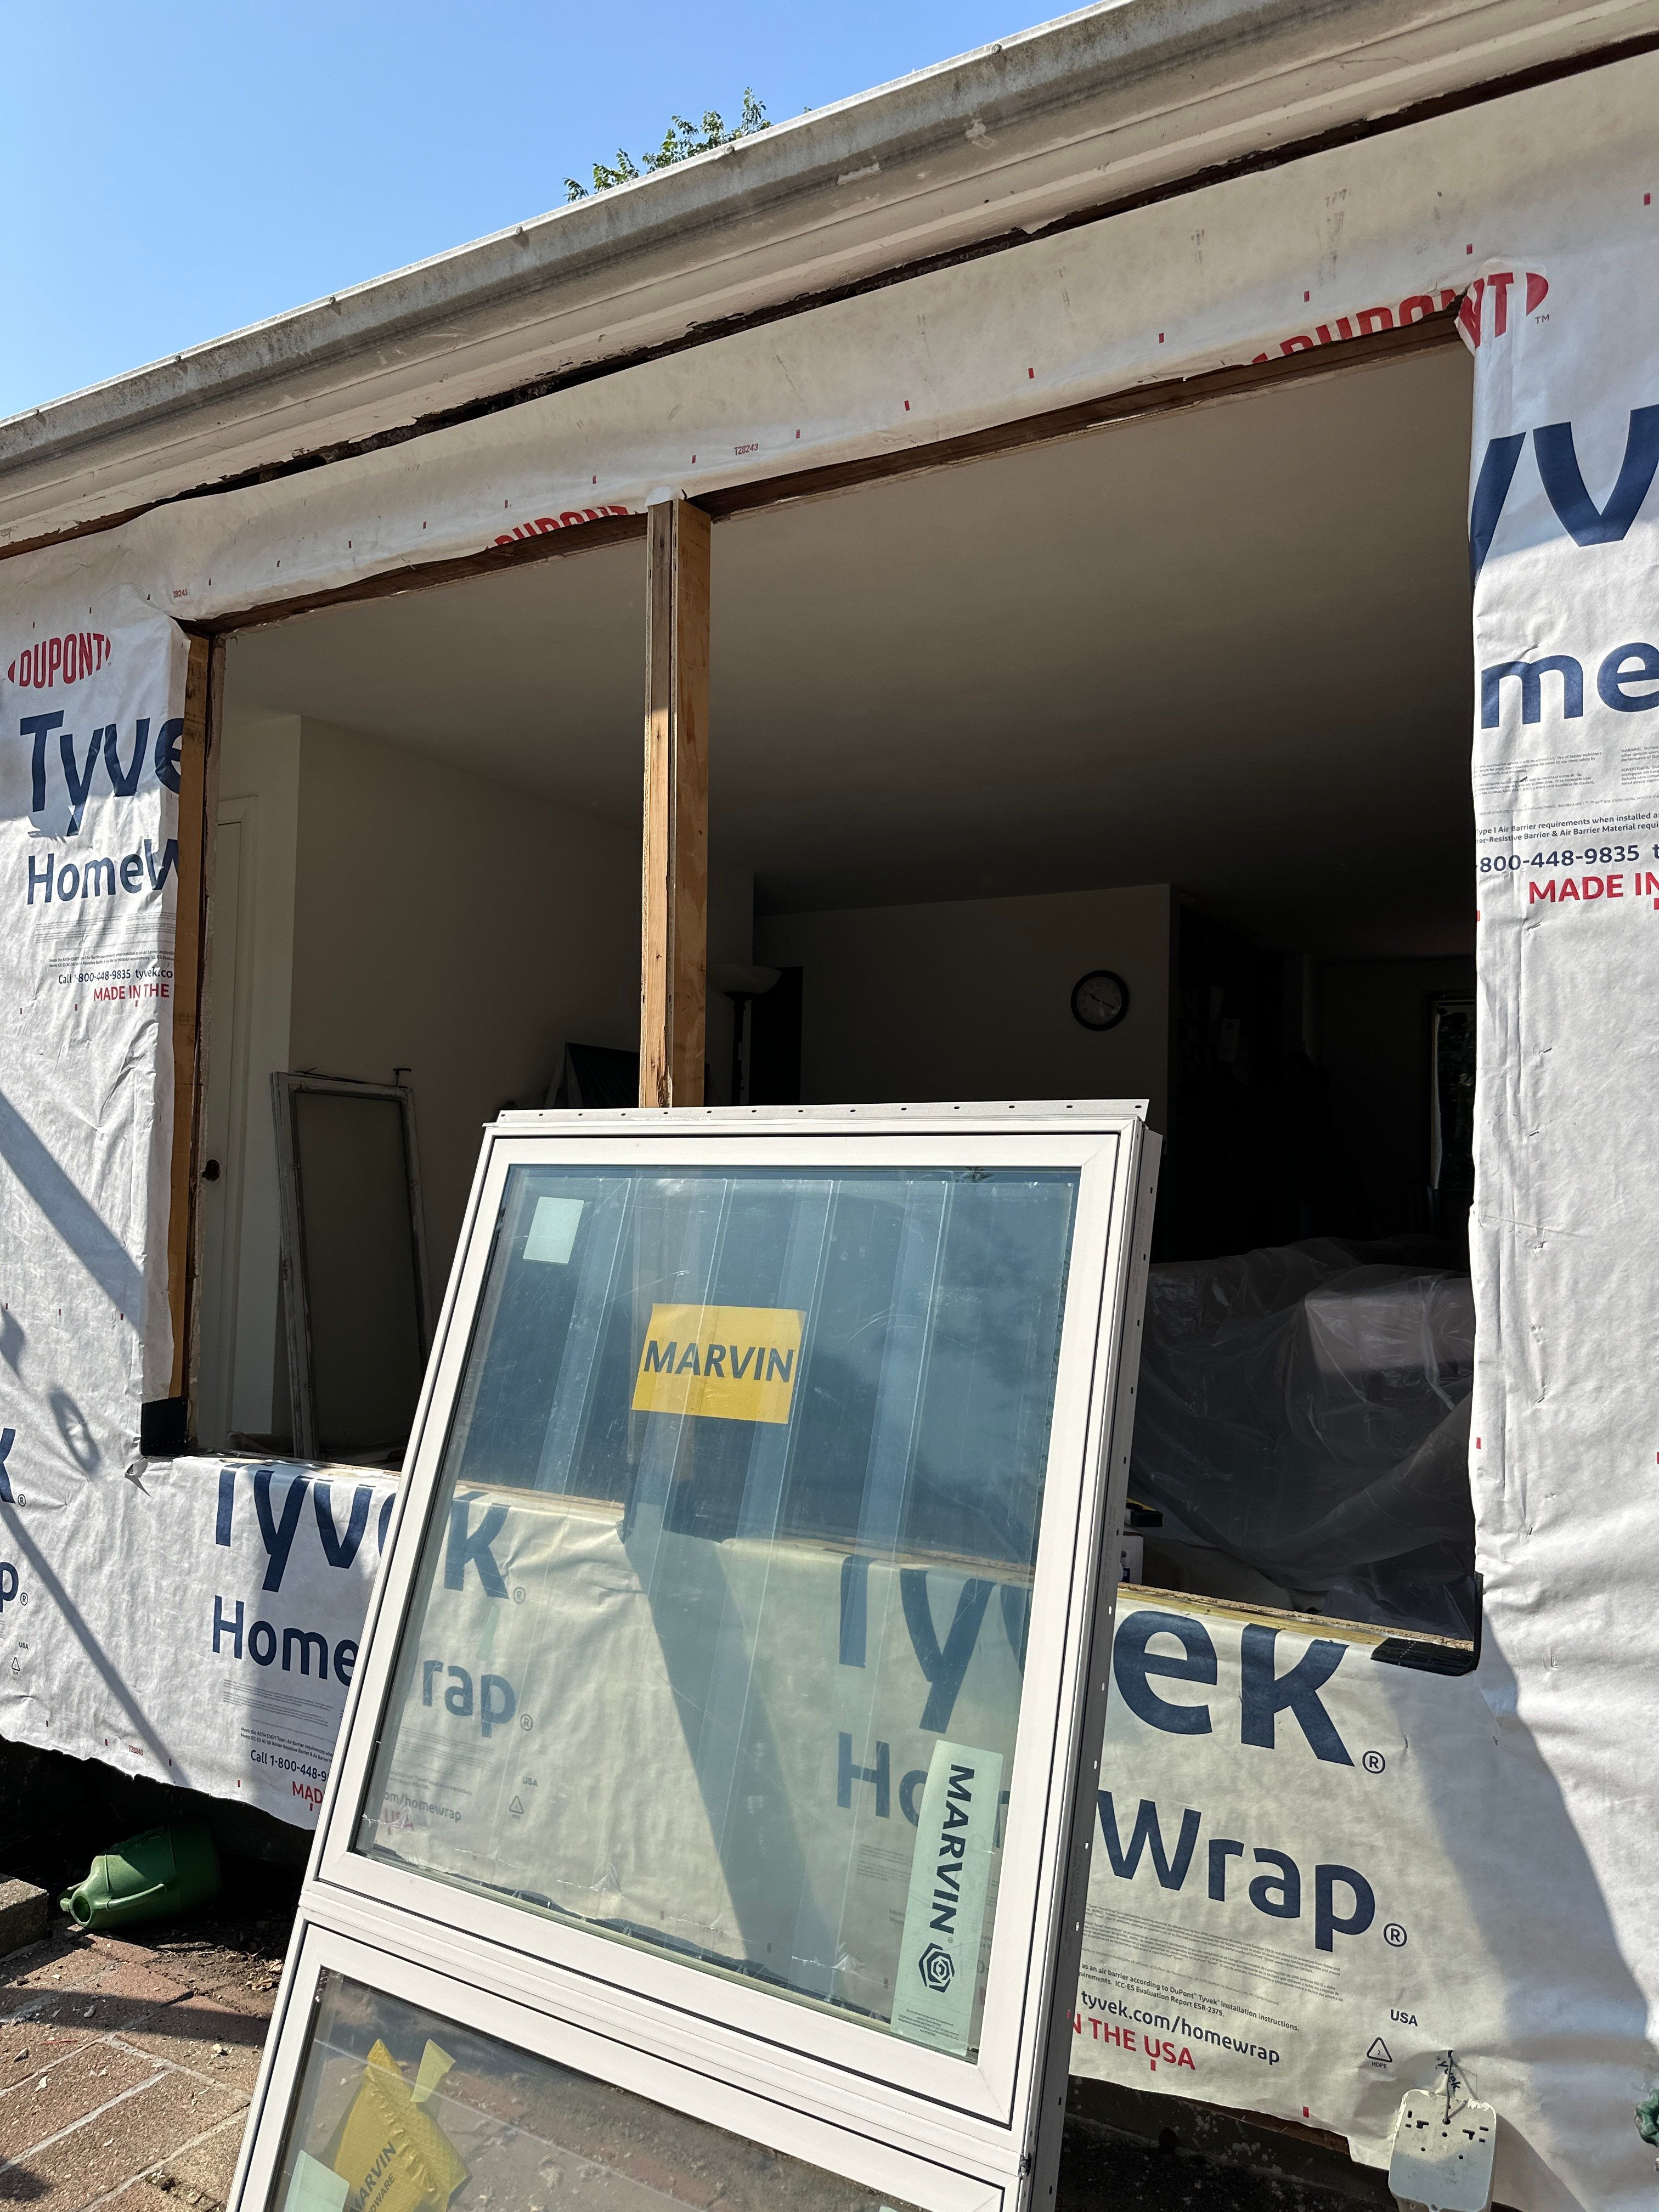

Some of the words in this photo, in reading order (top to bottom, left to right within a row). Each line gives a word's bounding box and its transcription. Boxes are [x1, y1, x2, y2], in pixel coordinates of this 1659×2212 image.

[733, 443, 759, 456] T28243
[19, 633, 105, 689] DUPONT
[1538, 819, 1590, 830] requirements
[1616, 812, 1651, 821] installed
[1524, 831, 1549, 839] Barrier
[1573, 827, 1600, 835] Barrier
[1602, 823, 1636, 832] Material
[1529, 874, 1624, 904] MADE
[59, 973, 72, 984] Call
[93, 986, 125, 1001] MADE
[129, 985, 140, 999] IN
[143, 984, 170, 998] THE
[644, 1340, 794, 1383] MARVIN
[19, 1641, 29, 1650] USA
[304, 1744, 325, 1754] requirements
[251, 1750, 267, 1764] Call
[270, 1755, 329, 1781] 1-800-448-9
[522, 1776, 538, 1787] USA
[1079, 1971, 1113, 1985] uirements.
[1115, 1980, 1135, 1991] ICC-ES
[1136, 1986, 1169, 2001] Evaluation
[1171, 1995, 1193, 2007] Report
[1194, 2002, 1225, 2017] ESR-2375.
[1108, 1970, 1128, 1981] barrier
[1130, 1977, 1160, 1990] according
[1221, 2000, 1257, 2018] installation
[1258, 2012, 1300, 2032] instructions.
[1390, 2008, 1418, 2027] USA
[1081, 1990, 1280, 2066] tyvek.com/homewrap
[1088, 2017, 1136, 2052] THE
[1144, 2035, 1196, 2070] USA
